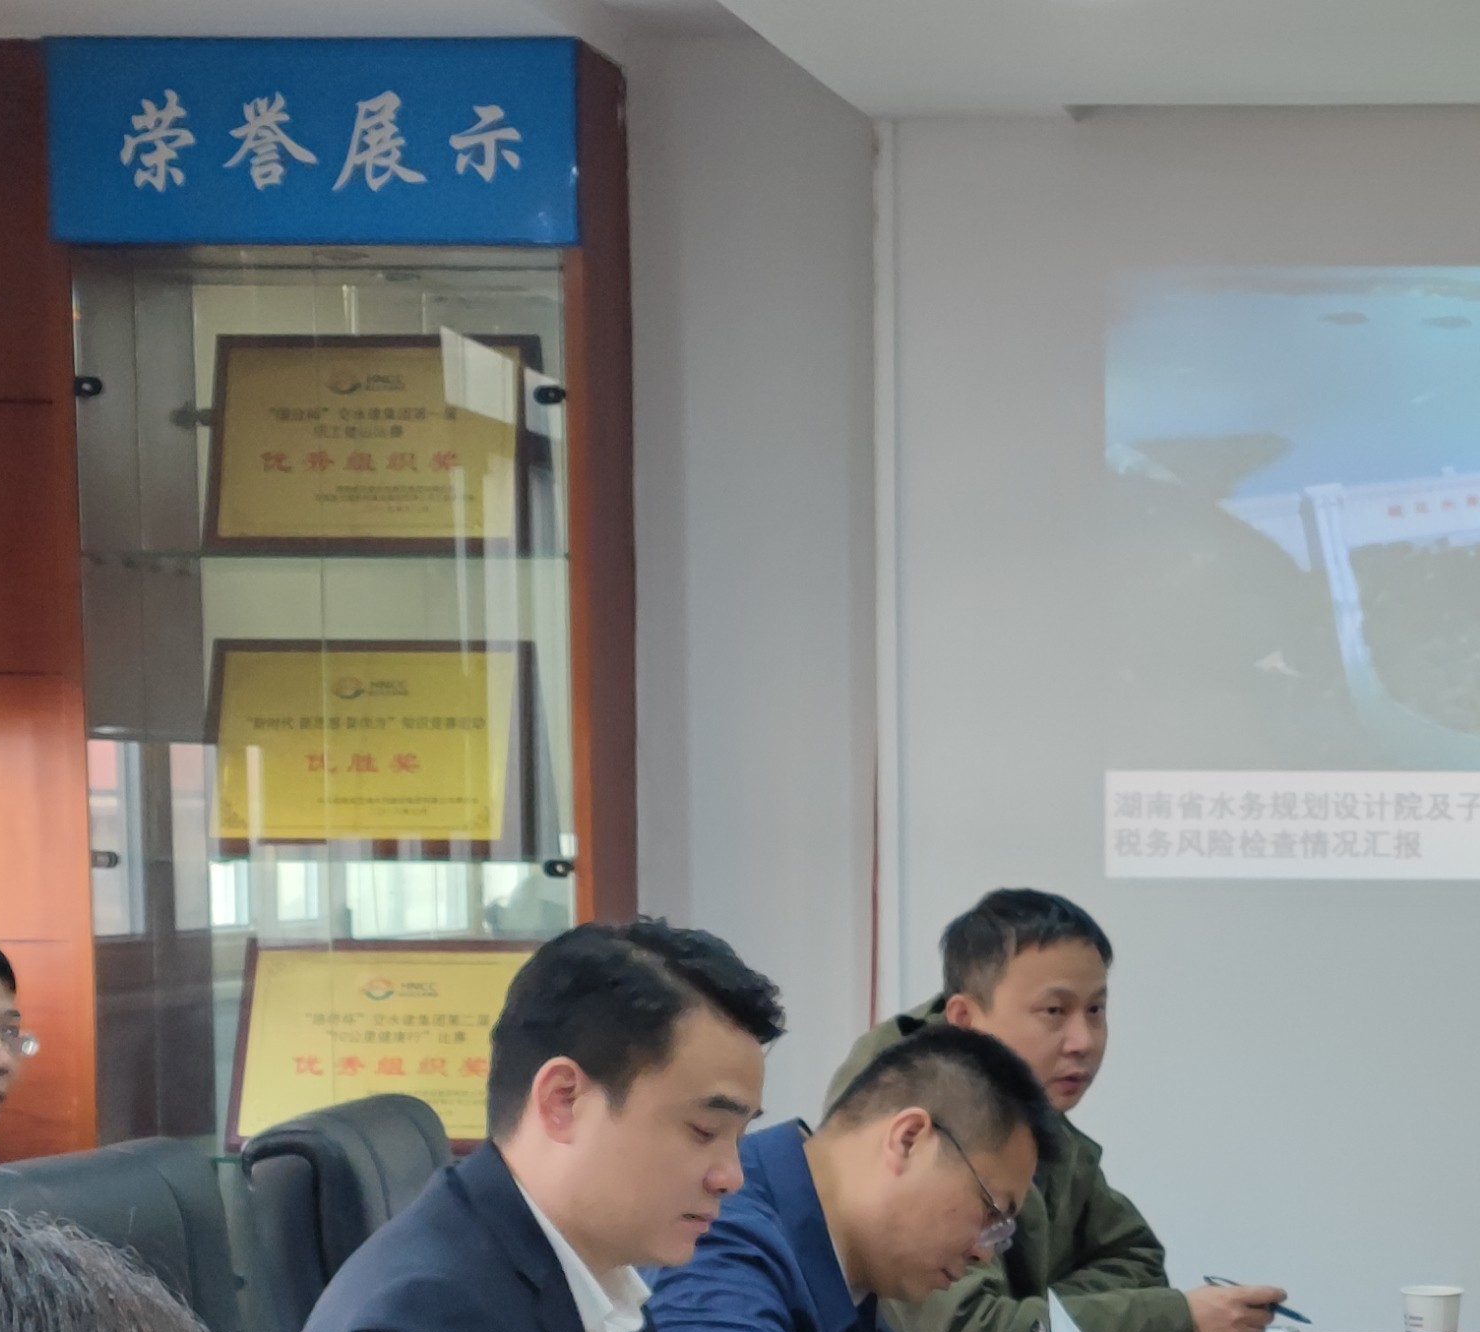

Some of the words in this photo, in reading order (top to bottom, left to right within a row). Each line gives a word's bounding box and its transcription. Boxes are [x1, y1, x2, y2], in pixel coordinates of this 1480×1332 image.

[119, 89, 522, 192] 荣誉展示
[260, 451, 458, 473] 优秀组织奖
[305, 752, 419, 774] 优胜奖
[1114, 827, 1422, 860] 税务风险检查情况汇报
[292, 1055, 490, 1078] 优秀组织奖
